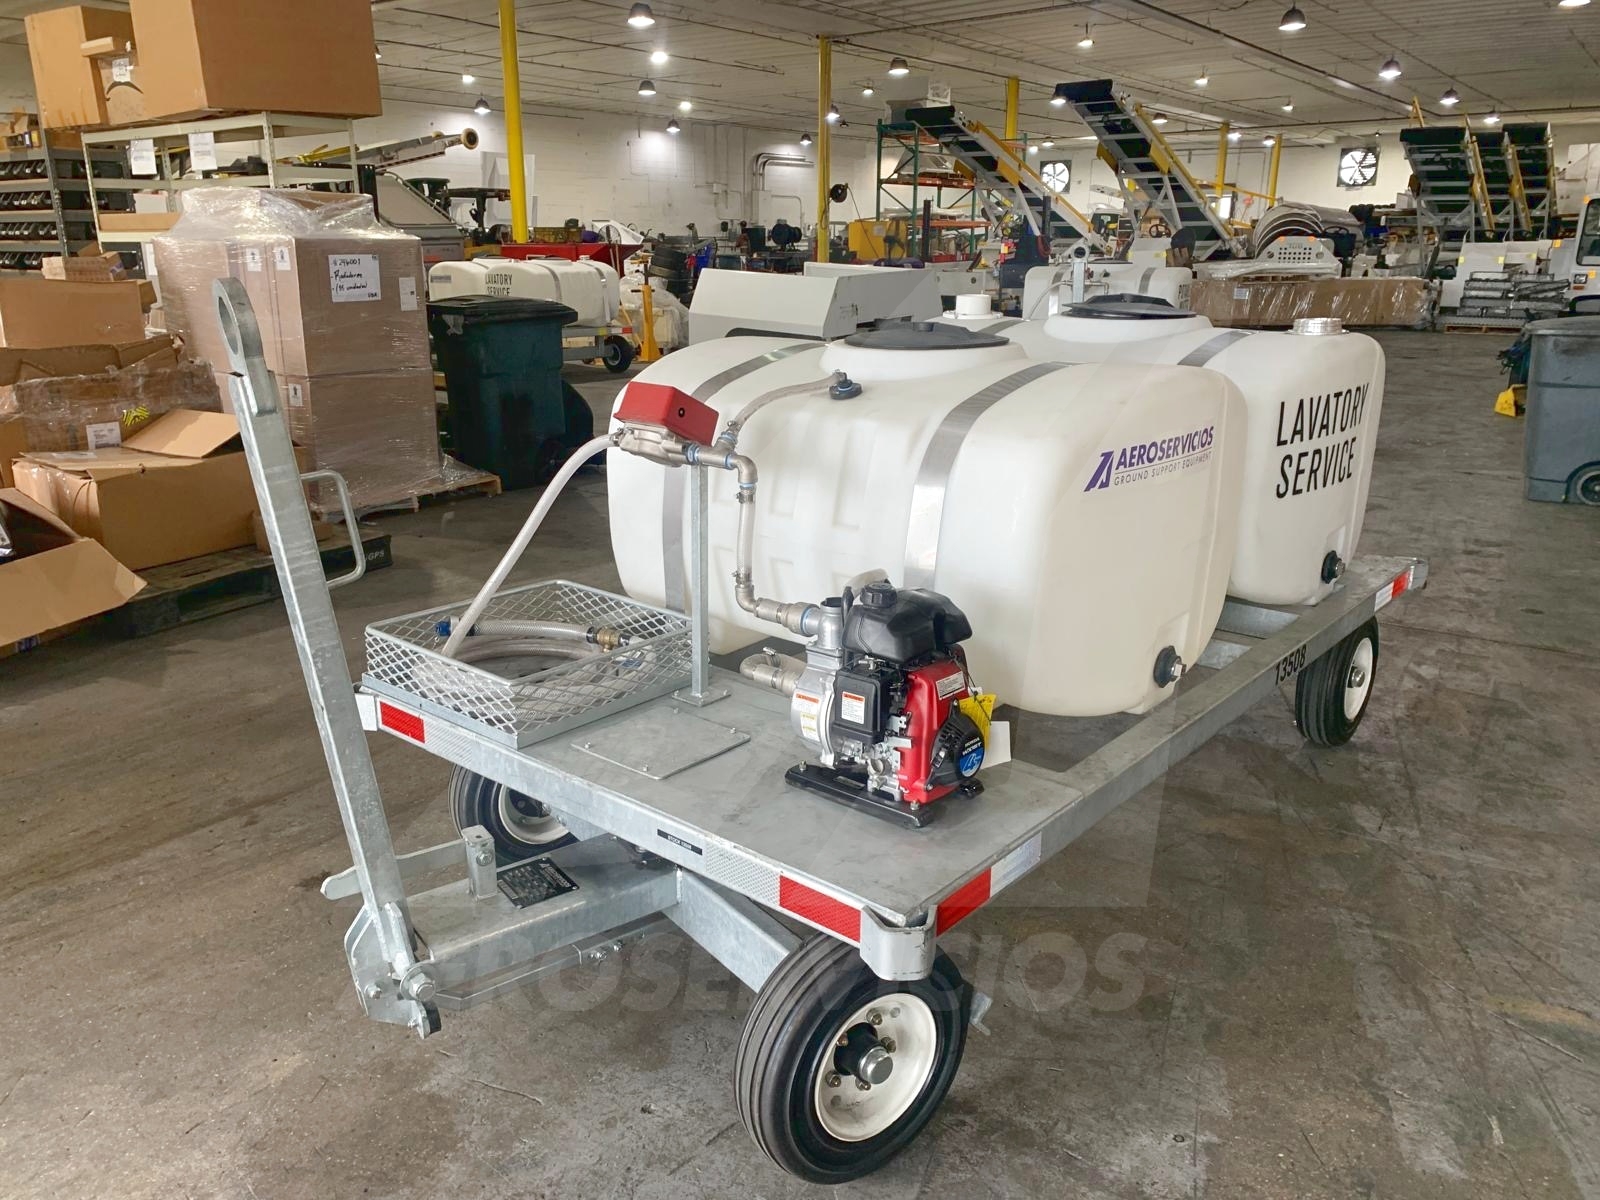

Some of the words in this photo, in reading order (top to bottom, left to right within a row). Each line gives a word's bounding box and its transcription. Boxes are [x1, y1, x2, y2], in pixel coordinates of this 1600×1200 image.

[485, 273, 513, 285] LAVATORY
[487, 286, 510, 296] SERVICE
[1276, 382, 1370, 447] LAVATORY
[1114, 425, 1215, 470] AEROSERVICIOS
[1114, 470, 1149, 486] GROUND
[1151, 460, 1181, 478] SUPPORT
[1181, 450, 1213, 469] EQUIPMENT
[1276, 436, 1357, 499] SERVICE
[1275, 643, 1307, 686] 13508
